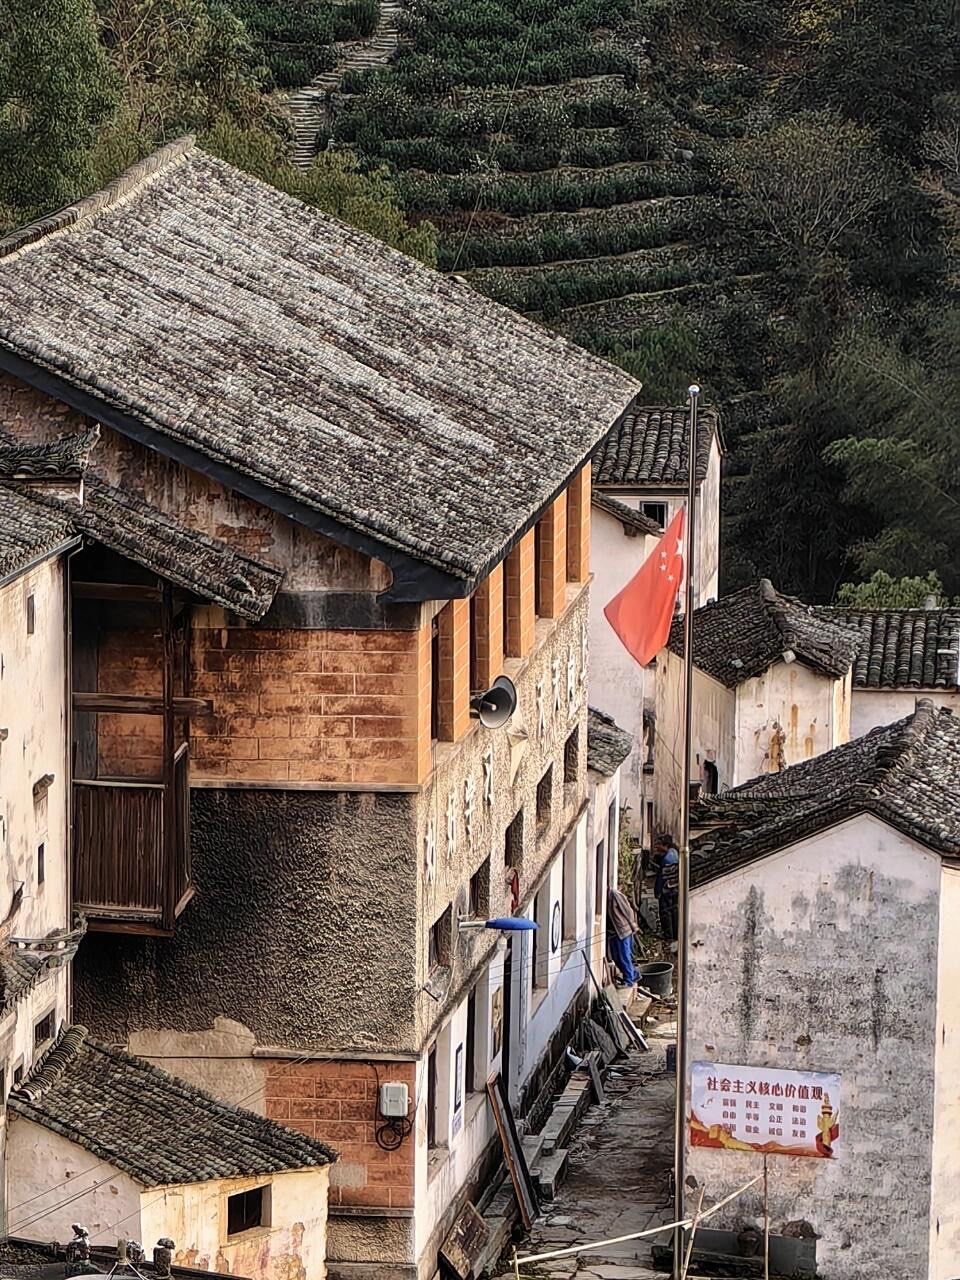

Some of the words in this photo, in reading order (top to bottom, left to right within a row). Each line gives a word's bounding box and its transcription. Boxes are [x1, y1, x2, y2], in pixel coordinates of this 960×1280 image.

[707, 1076, 823, 1100] 社会主义核心价值观
[745, 1100, 760, 1109] 民主
[722, 1110, 737, 1119] 自由
[745, 1112, 760, 1121] 平等
[769, 1114, 783, 1124] 公正
[792, 1117, 807, 1126] 法治
